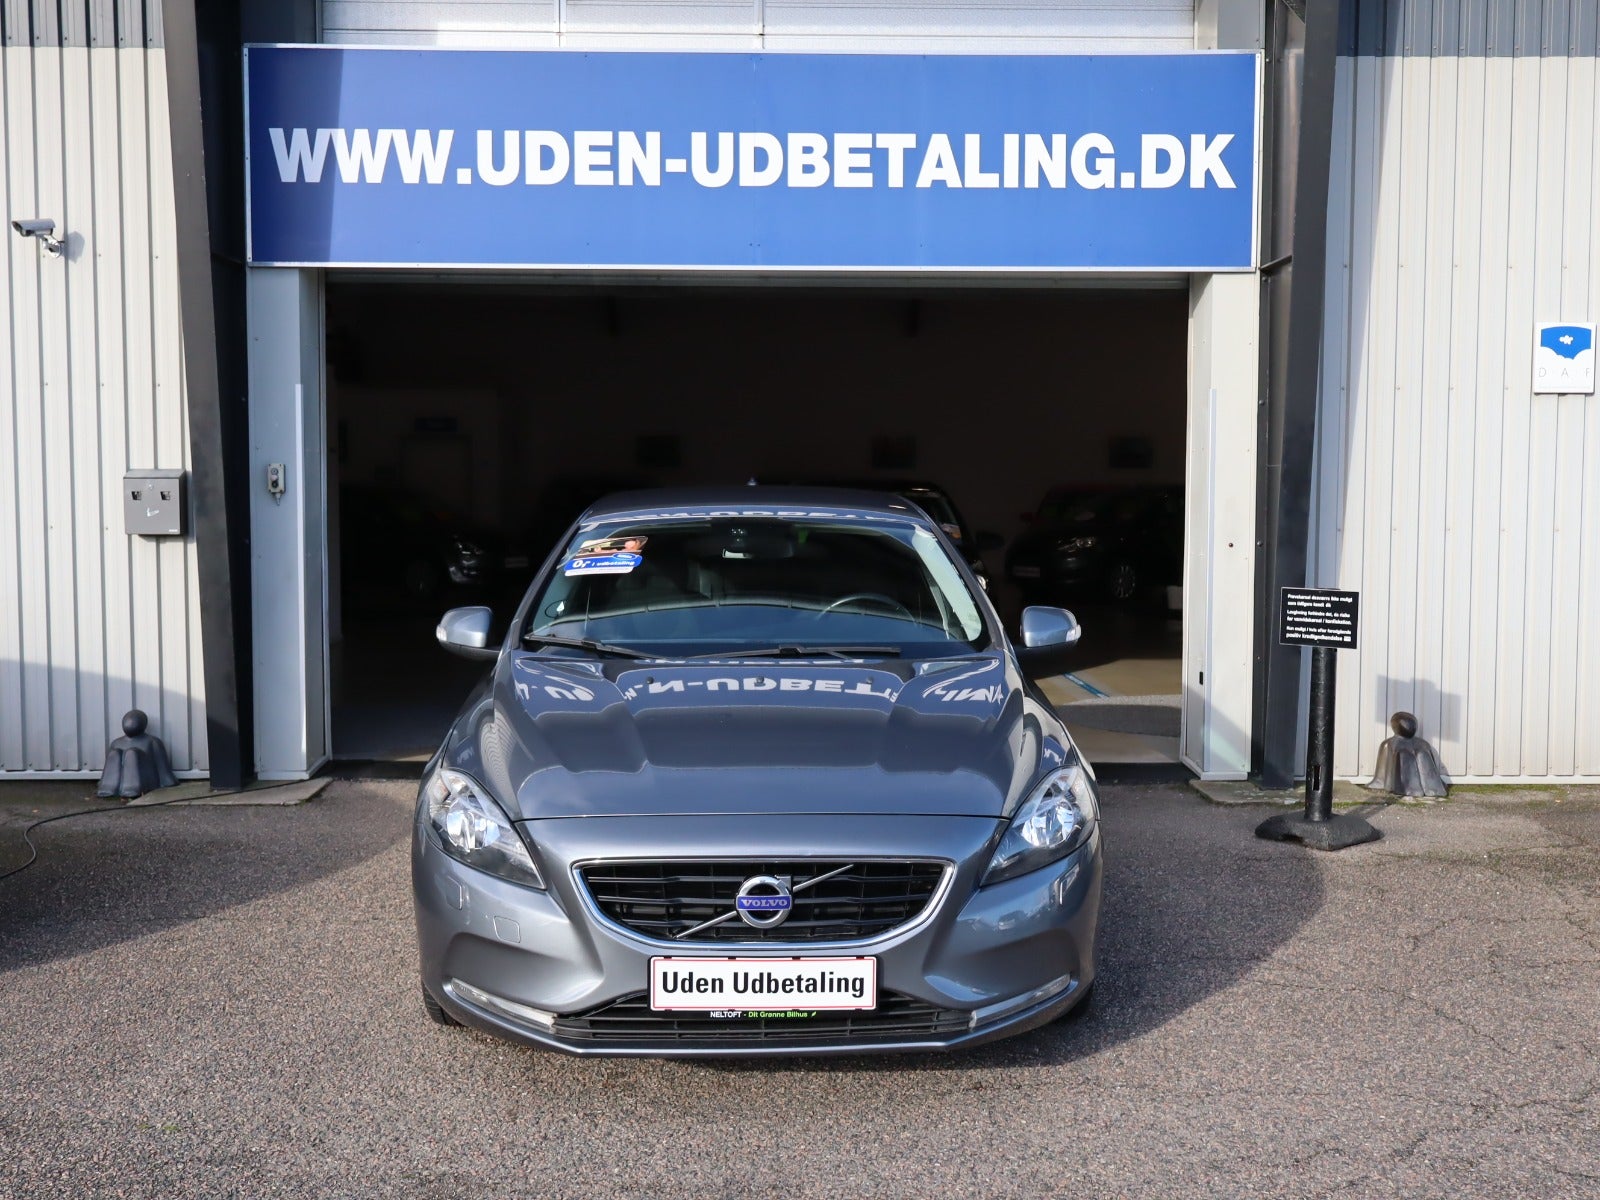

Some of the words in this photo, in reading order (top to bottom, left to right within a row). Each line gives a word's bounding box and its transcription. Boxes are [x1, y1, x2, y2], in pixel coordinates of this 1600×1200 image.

[269, 127, 1236, 190] WWW.UDEN-UDBETALING.DK
[740, 899, 788, 907] VOLVO
[662, 971, 724, 994] Uden
[733, 971, 865, 999] Udbetaling
